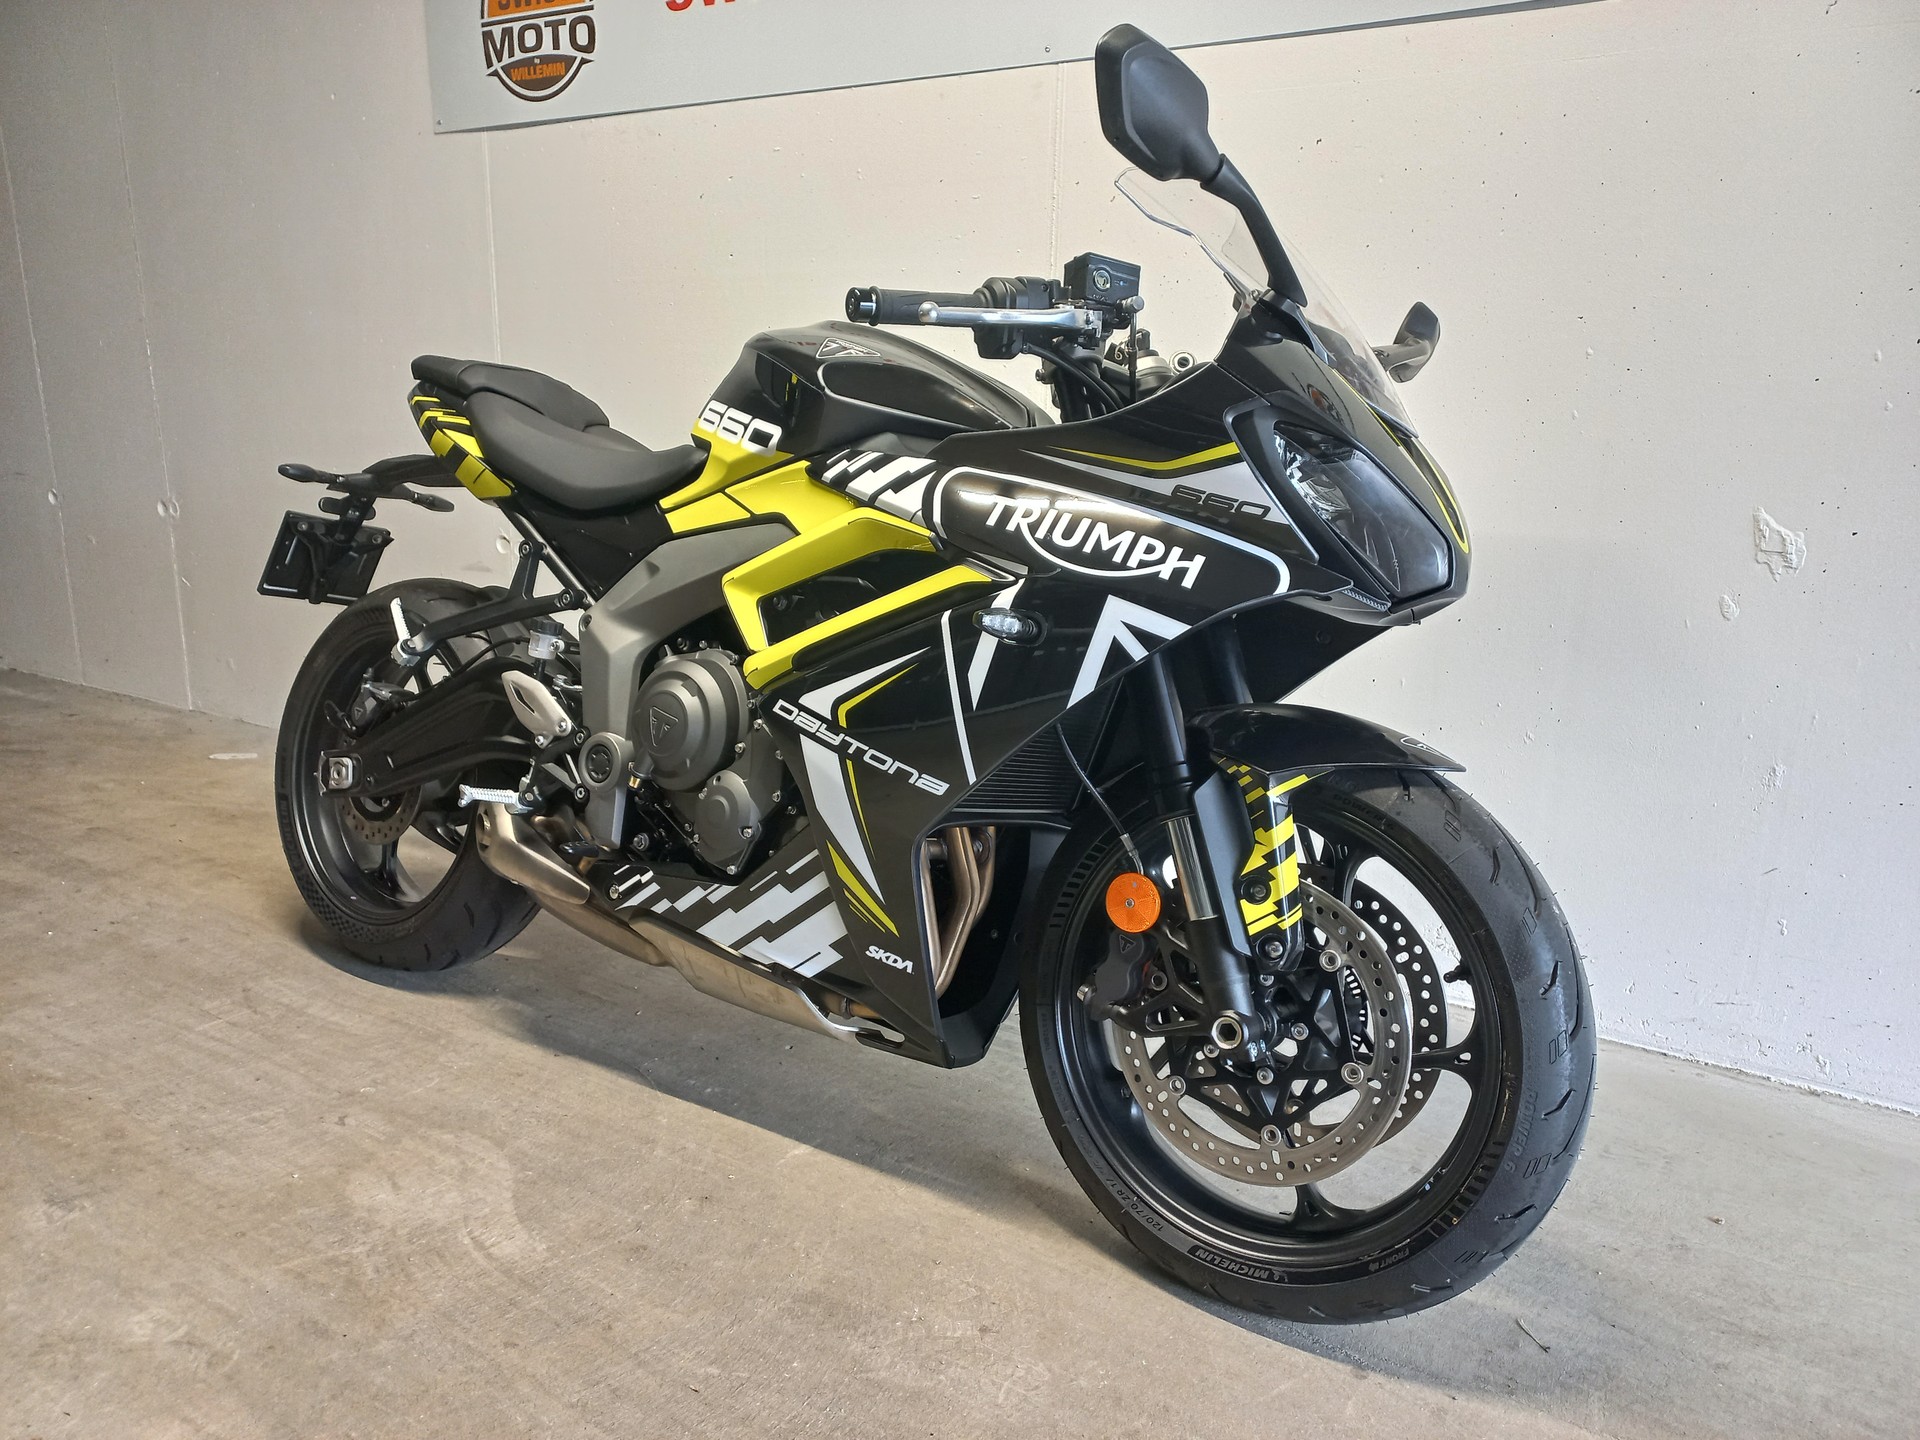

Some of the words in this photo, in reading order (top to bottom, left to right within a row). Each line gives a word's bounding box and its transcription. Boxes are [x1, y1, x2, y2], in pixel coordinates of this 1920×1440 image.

[482, 15, 596, 69] MOTO
[511, 62, 565, 81] WILLEMIN
[698, 400, 782, 457] 660
[1171, 484, 1272, 519] 660
[985, 499, 1207, 590] TRIUMPH
[1511, 1089, 1538, 1156] POWER
[1116, 1188, 1131, 1203] ZR
[1130, 1202, 1165, 1232] 120/70
[1196, 1248, 1270, 1279] MICHELIN
[1378, 1247, 1410, 1268] FRONT
